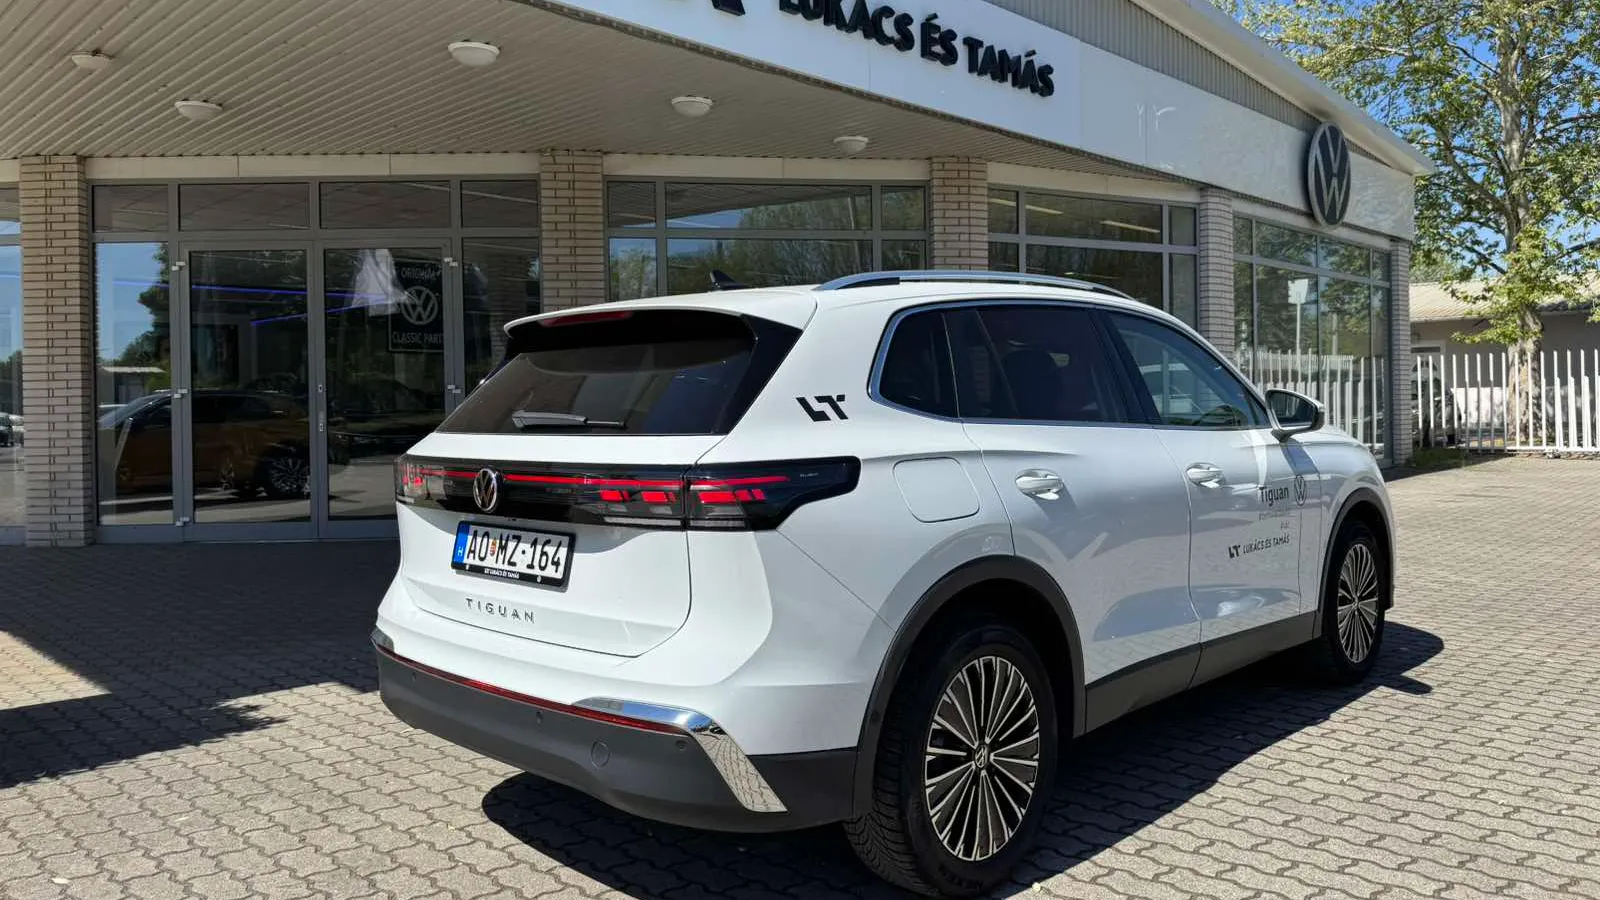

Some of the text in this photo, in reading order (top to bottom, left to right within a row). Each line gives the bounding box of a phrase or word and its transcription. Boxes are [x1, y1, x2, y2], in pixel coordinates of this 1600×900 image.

[921, 13, 958, 67] ÉS
[963, 36, 1055, 97] TAMÁS
[392, 331, 444, 345] CLASSIC PART
[1259, 486, 1289, 507] Tiguan
[465, 598, 535, 623] TIGUAN
